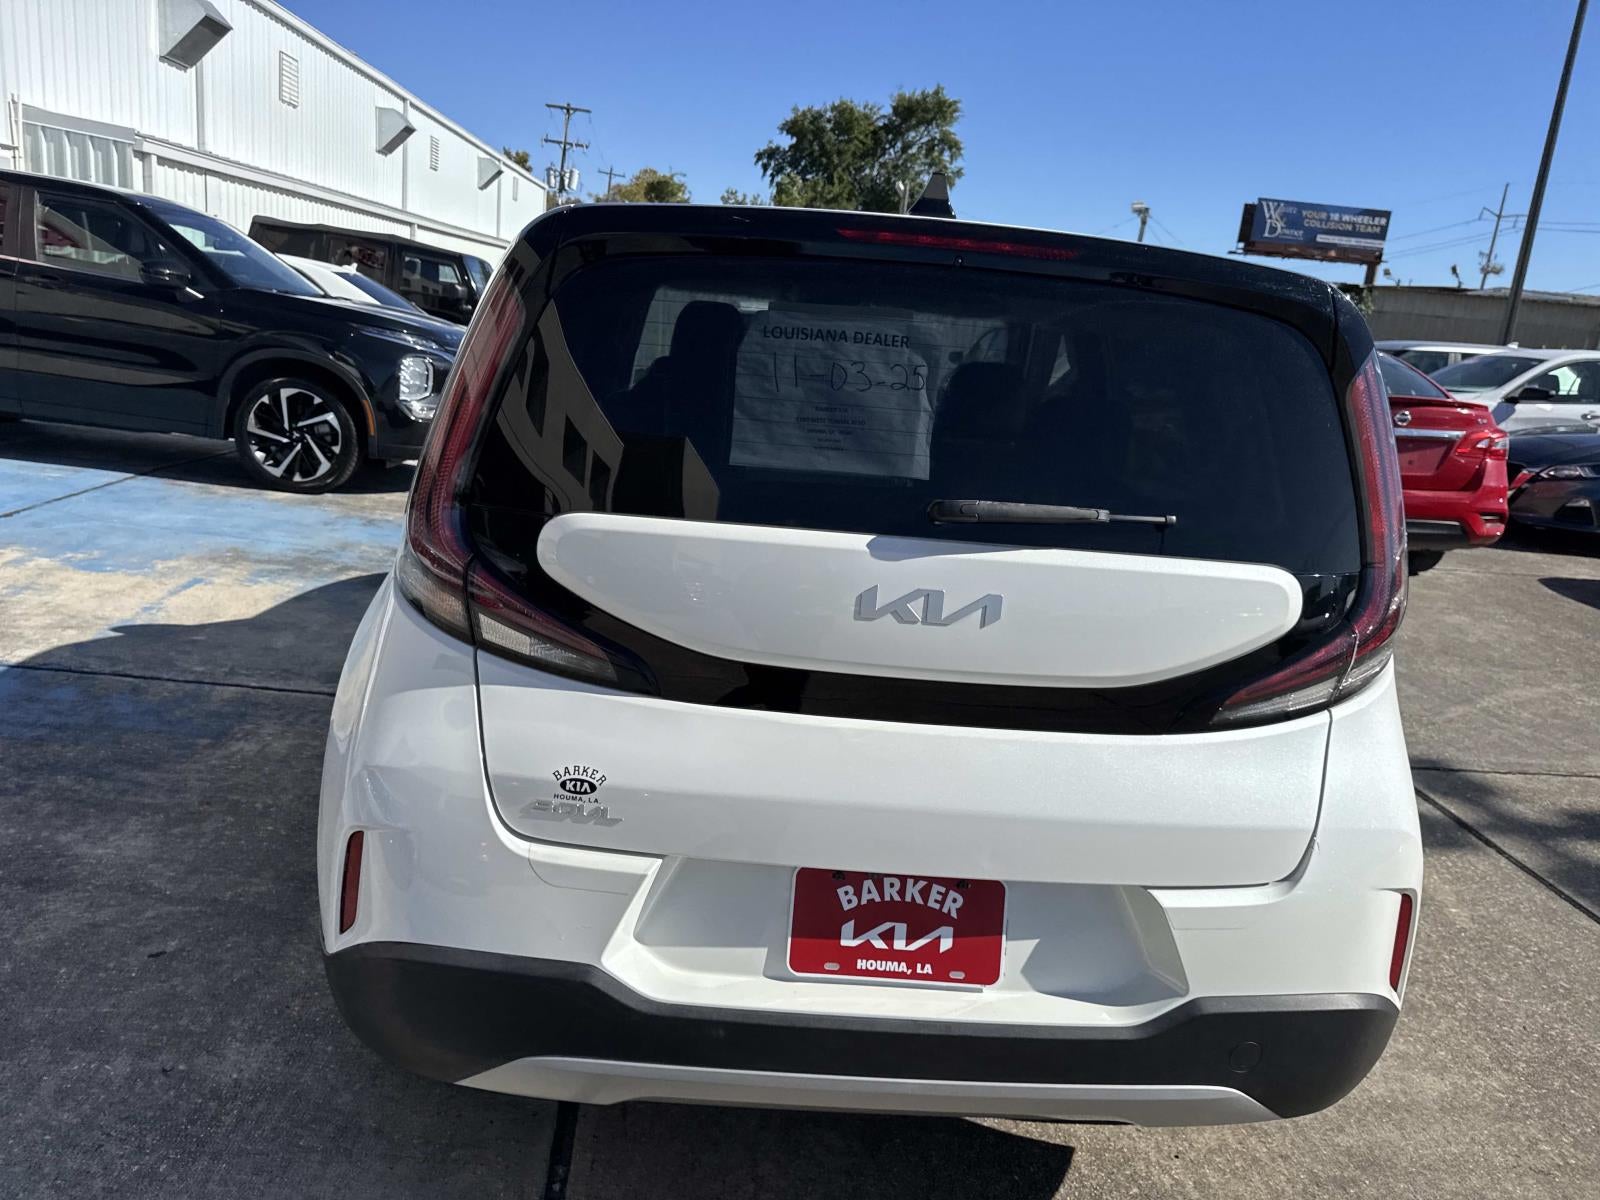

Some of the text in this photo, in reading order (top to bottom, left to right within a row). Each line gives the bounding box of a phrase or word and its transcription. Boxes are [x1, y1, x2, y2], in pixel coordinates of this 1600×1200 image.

[1302, 209, 1328, 220] YOUR
[1342, 213, 1387, 226] WHEELER
[1303, 219, 1352, 231] COLLISION
[1355, 224, 1381, 234] TEAM
[763, 325, 910, 348] LOUISIANA DEALER
[853, 584, 1004, 629] KIA
[552, 765, 607, 786] BARKER
[565, 780, 592, 794] KIA
[553, 793, 586, 803] HOUMA,
[836, 877, 963, 919] BARKER
[840, 919, 953, 953] KIA
[857, 959, 933, 975] HOUMA, LA
